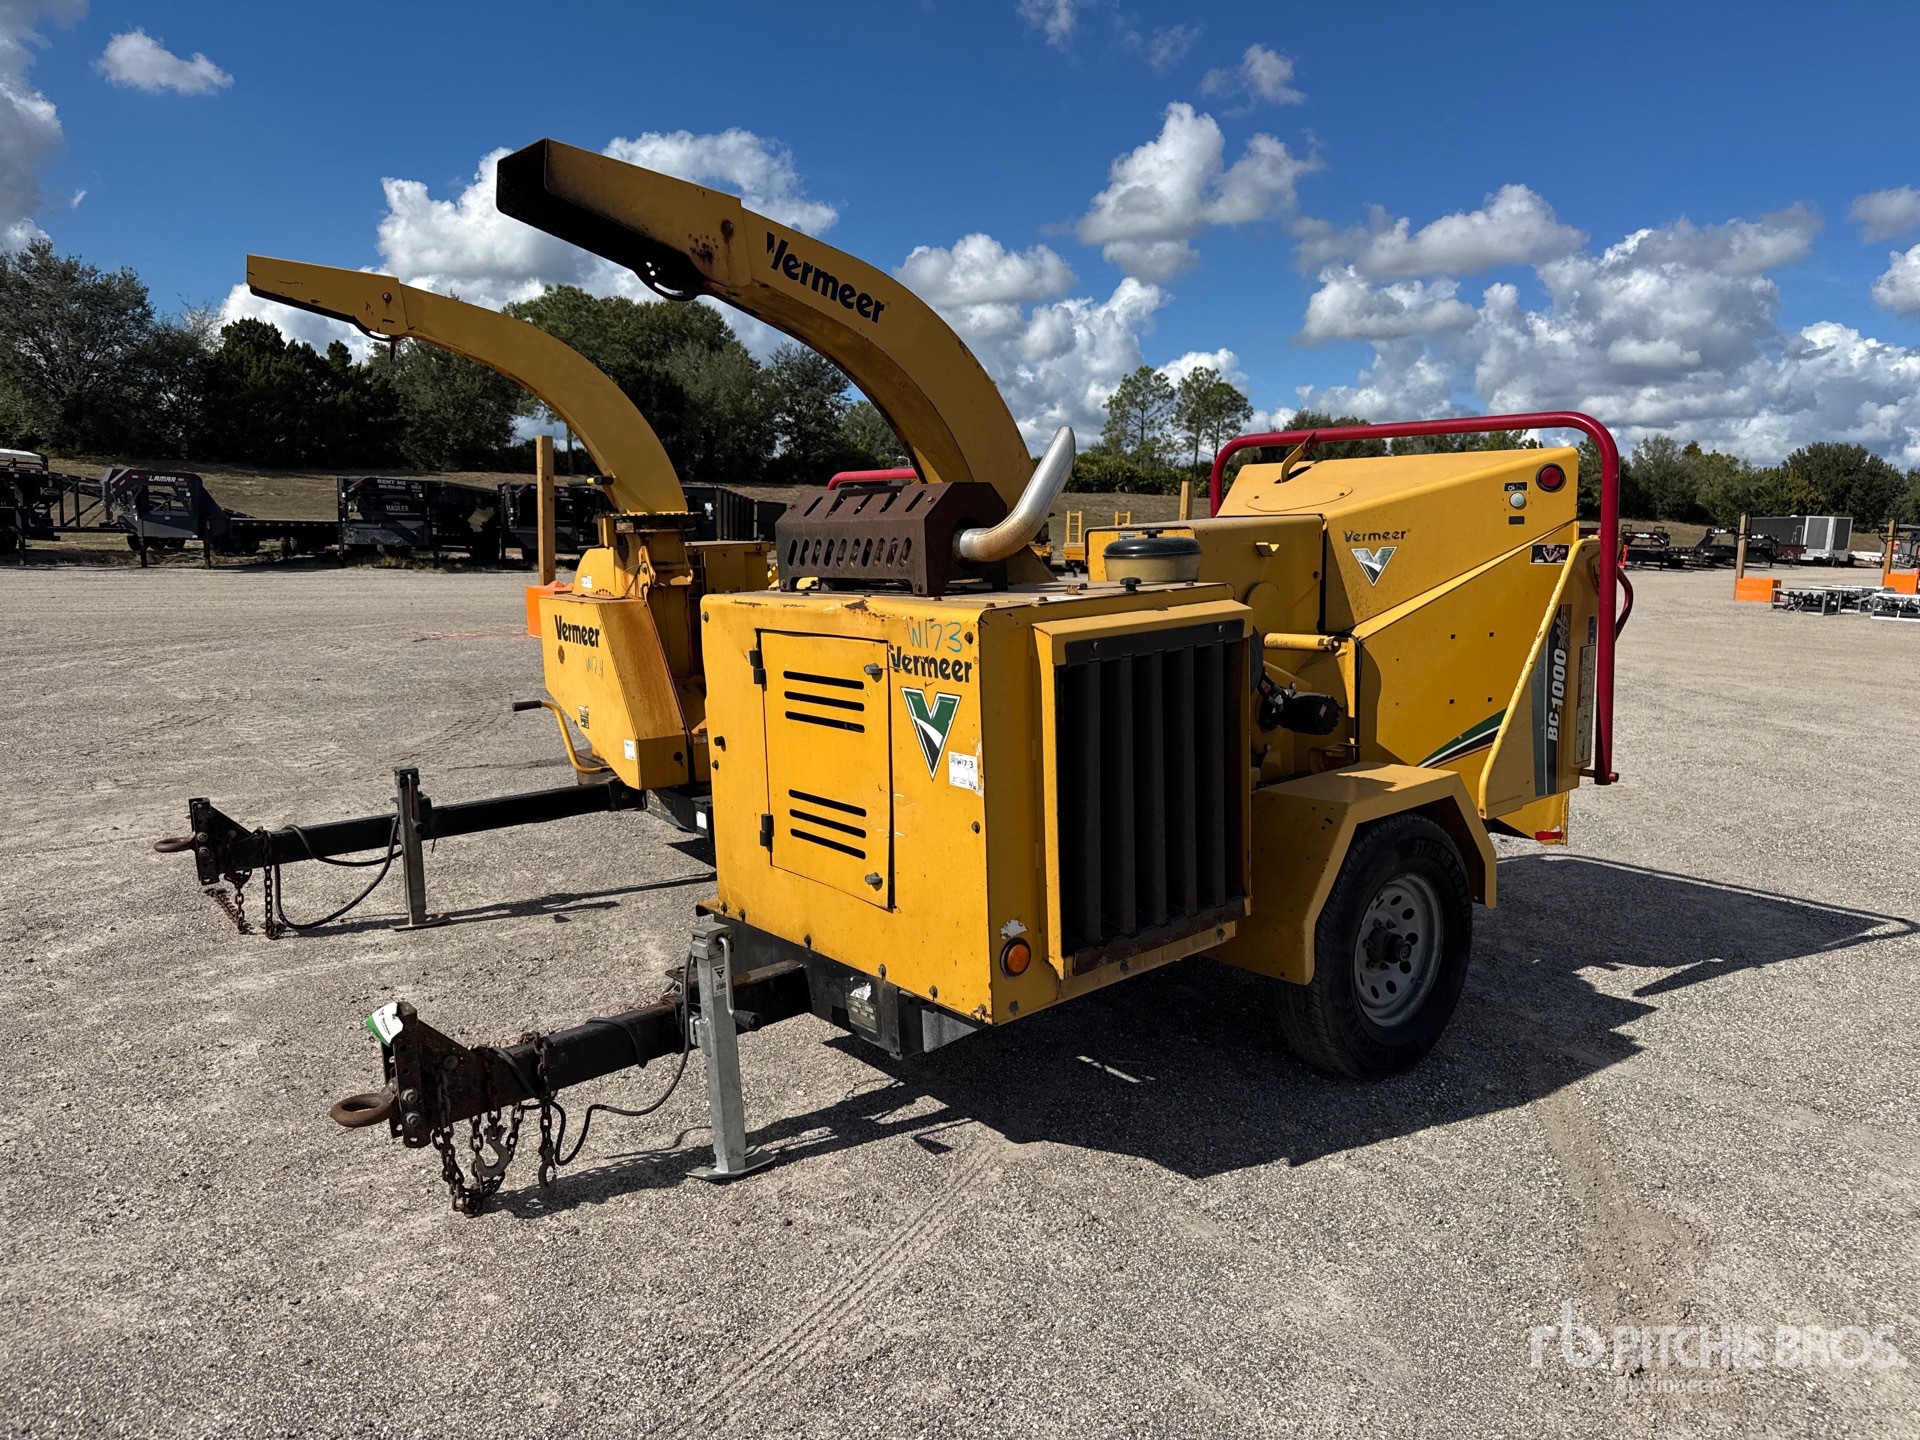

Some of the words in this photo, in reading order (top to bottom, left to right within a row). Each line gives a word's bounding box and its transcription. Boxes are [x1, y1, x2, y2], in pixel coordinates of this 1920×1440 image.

[767, 231, 886, 324] Vermeer
[148, 475, 177, 483] LAMAR
[1343, 530, 1407, 543] Vermeer
[554, 614, 600, 648] Vermeer
[890, 646, 973, 683] Vermeer
